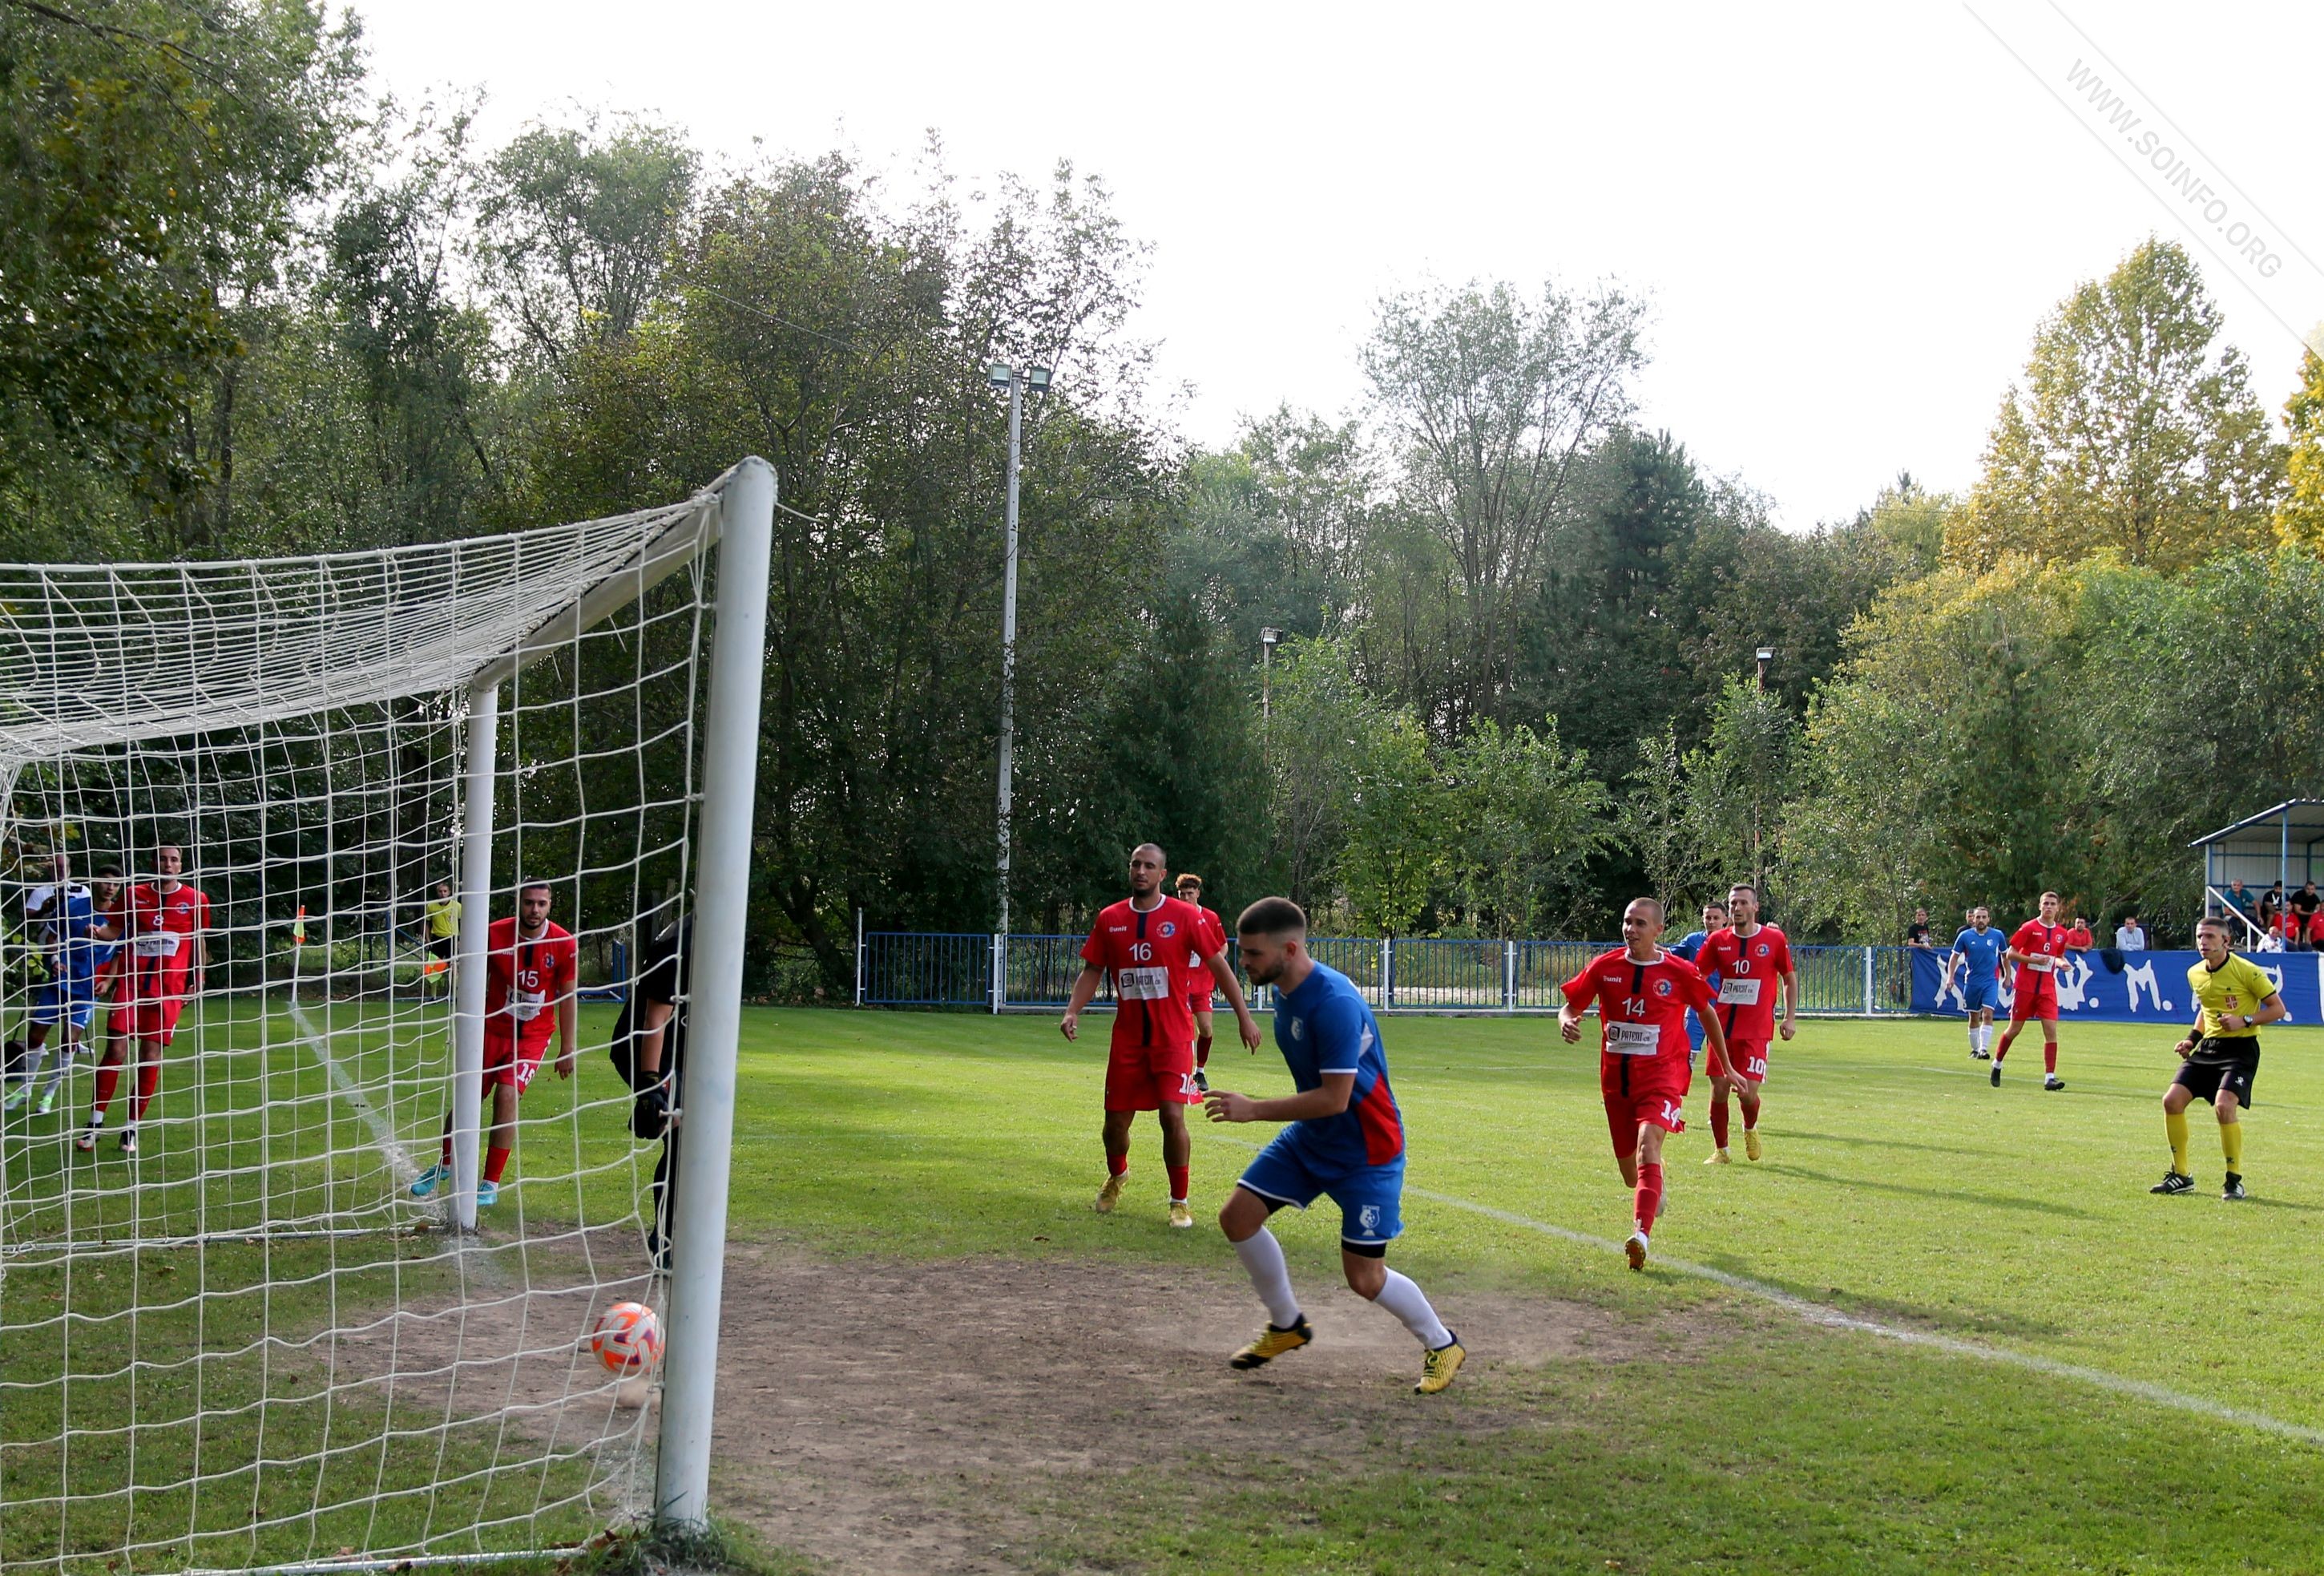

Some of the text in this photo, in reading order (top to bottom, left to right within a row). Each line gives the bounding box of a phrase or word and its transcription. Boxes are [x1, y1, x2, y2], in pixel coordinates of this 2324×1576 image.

[153, 915, 164, 926] 8
[1128, 942, 1152, 962] 16
[2043, 942, 2051, 952] 6
[1732, 959, 1750, 975] 10
[518, 969, 539, 988] 15
[1622, 997, 1646, 1017] 14
[1620, 1030, 1643, 1042] PATENT
[1747, 1056, 1765, 1075] 10
[1660, 1099, 1681, 1129] 14
